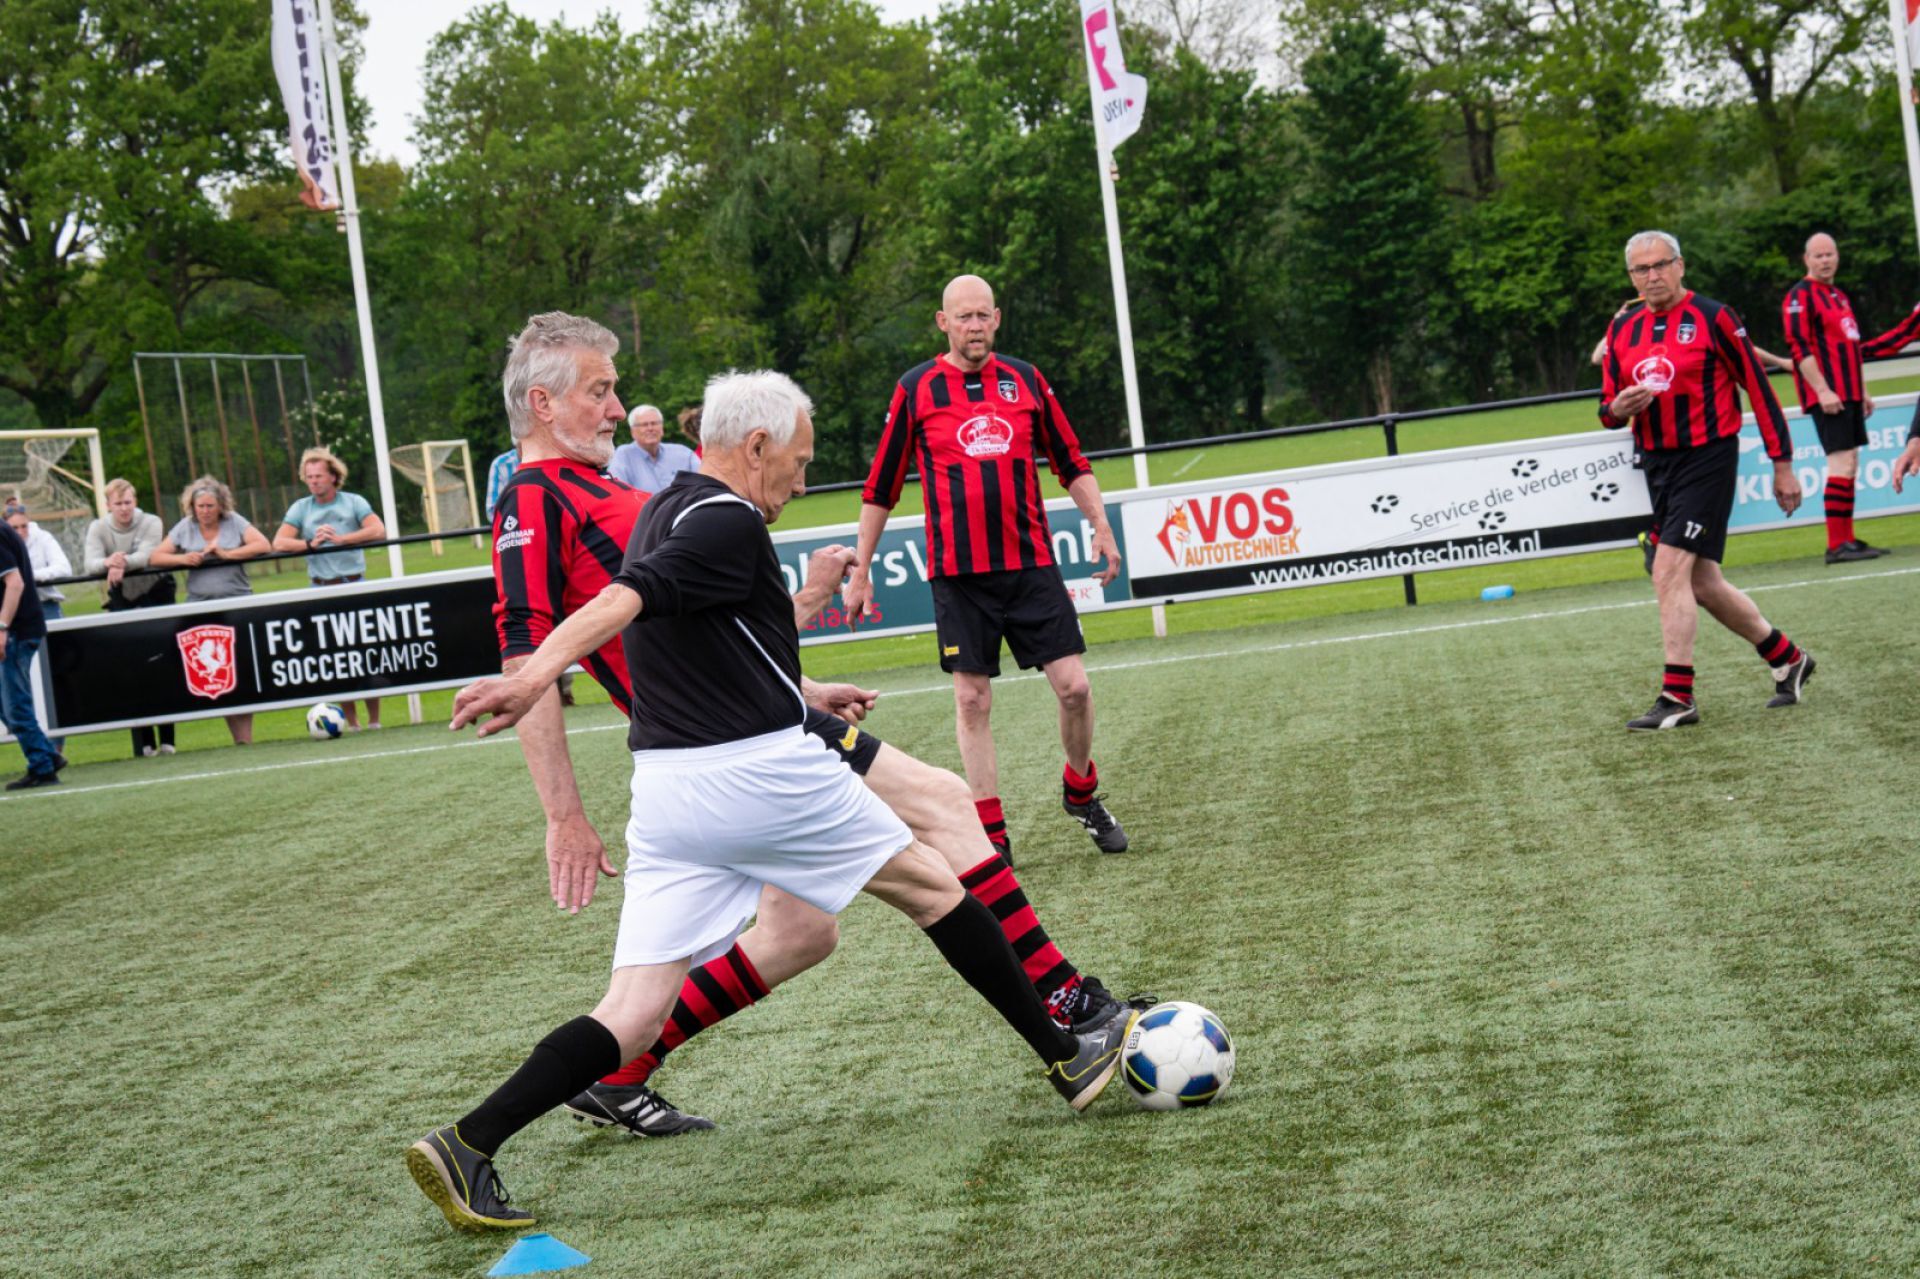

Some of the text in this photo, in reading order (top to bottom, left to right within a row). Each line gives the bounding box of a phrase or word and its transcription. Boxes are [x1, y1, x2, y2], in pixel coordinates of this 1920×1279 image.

[1188, 487, 1294, 543] VOS
[1410, 498, 1479, 532] Service
[1483, 488, 1513, 508] die
[1517, 467, 1579, 497] verder
[1184, 527, 1301, 567] AUTOTECHNIEK
[1684, 520, 1703, 539] 17
[1251, 531, 1541, 585] www.vosautotechniek.nl
[265, 602, 434, 655] FC TWENTE
[271, 641, 438, 687] SOCCERCAMPS
